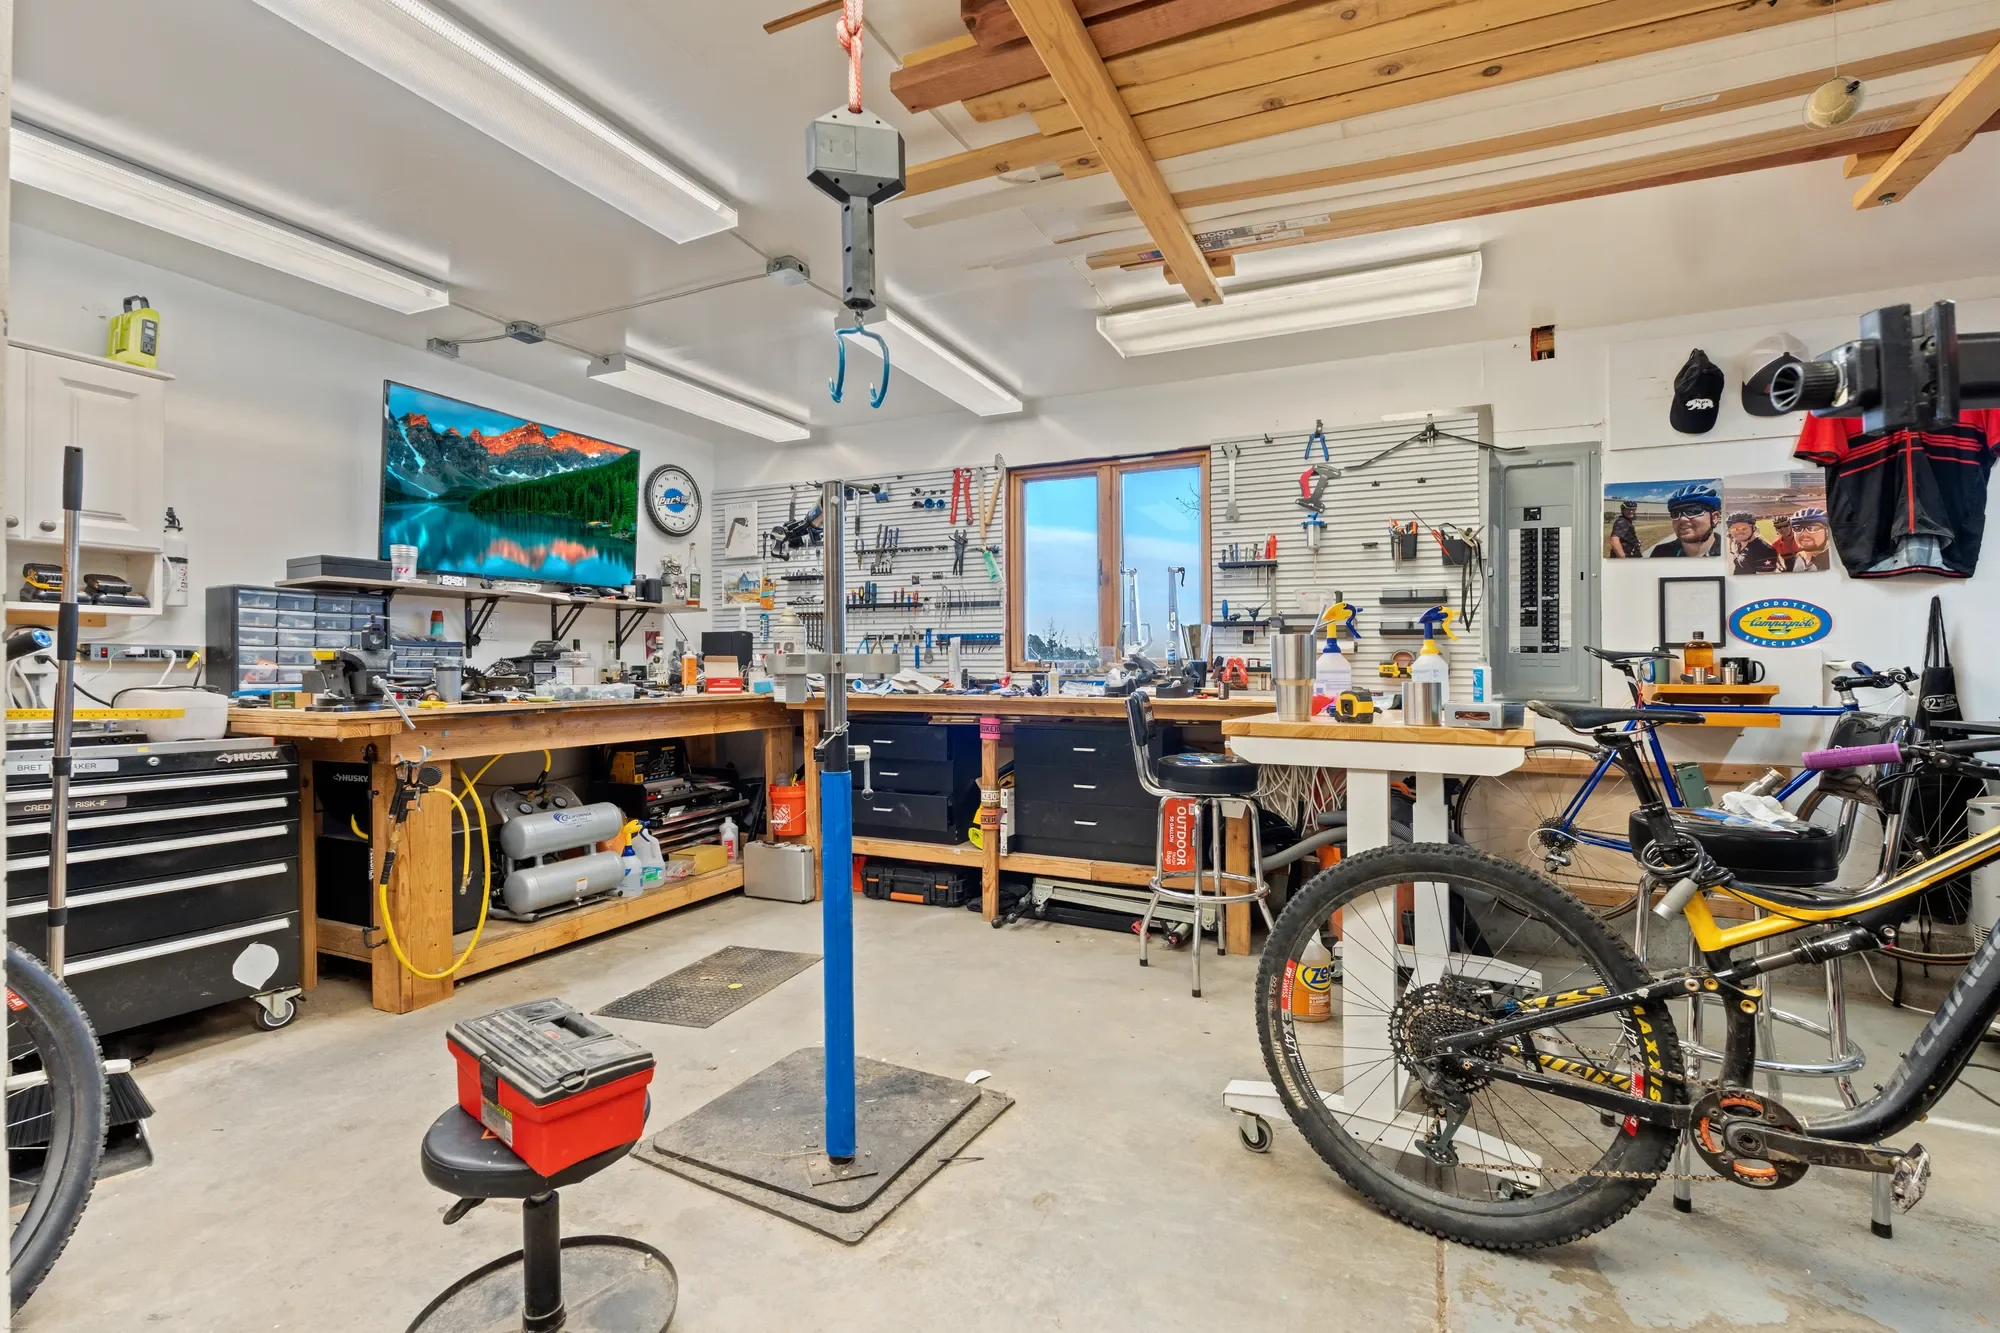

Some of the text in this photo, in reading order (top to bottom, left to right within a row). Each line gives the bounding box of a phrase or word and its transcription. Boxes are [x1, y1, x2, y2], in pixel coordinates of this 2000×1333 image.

[1746, 601, 1814, 612] PRODOTTI
[1743, 616, 1818, 629] Campagnolo
[1745, 635, 1813, 647] SPECIALI
[233, 750, 278, 762] HUSKY
[16, 764, 42, 772] BRET
[342, 773, 369, 782] HUSKY
[1177, 806, 1187, 866] OUTDOOR
[1285, 967, 1293, 978] DT
